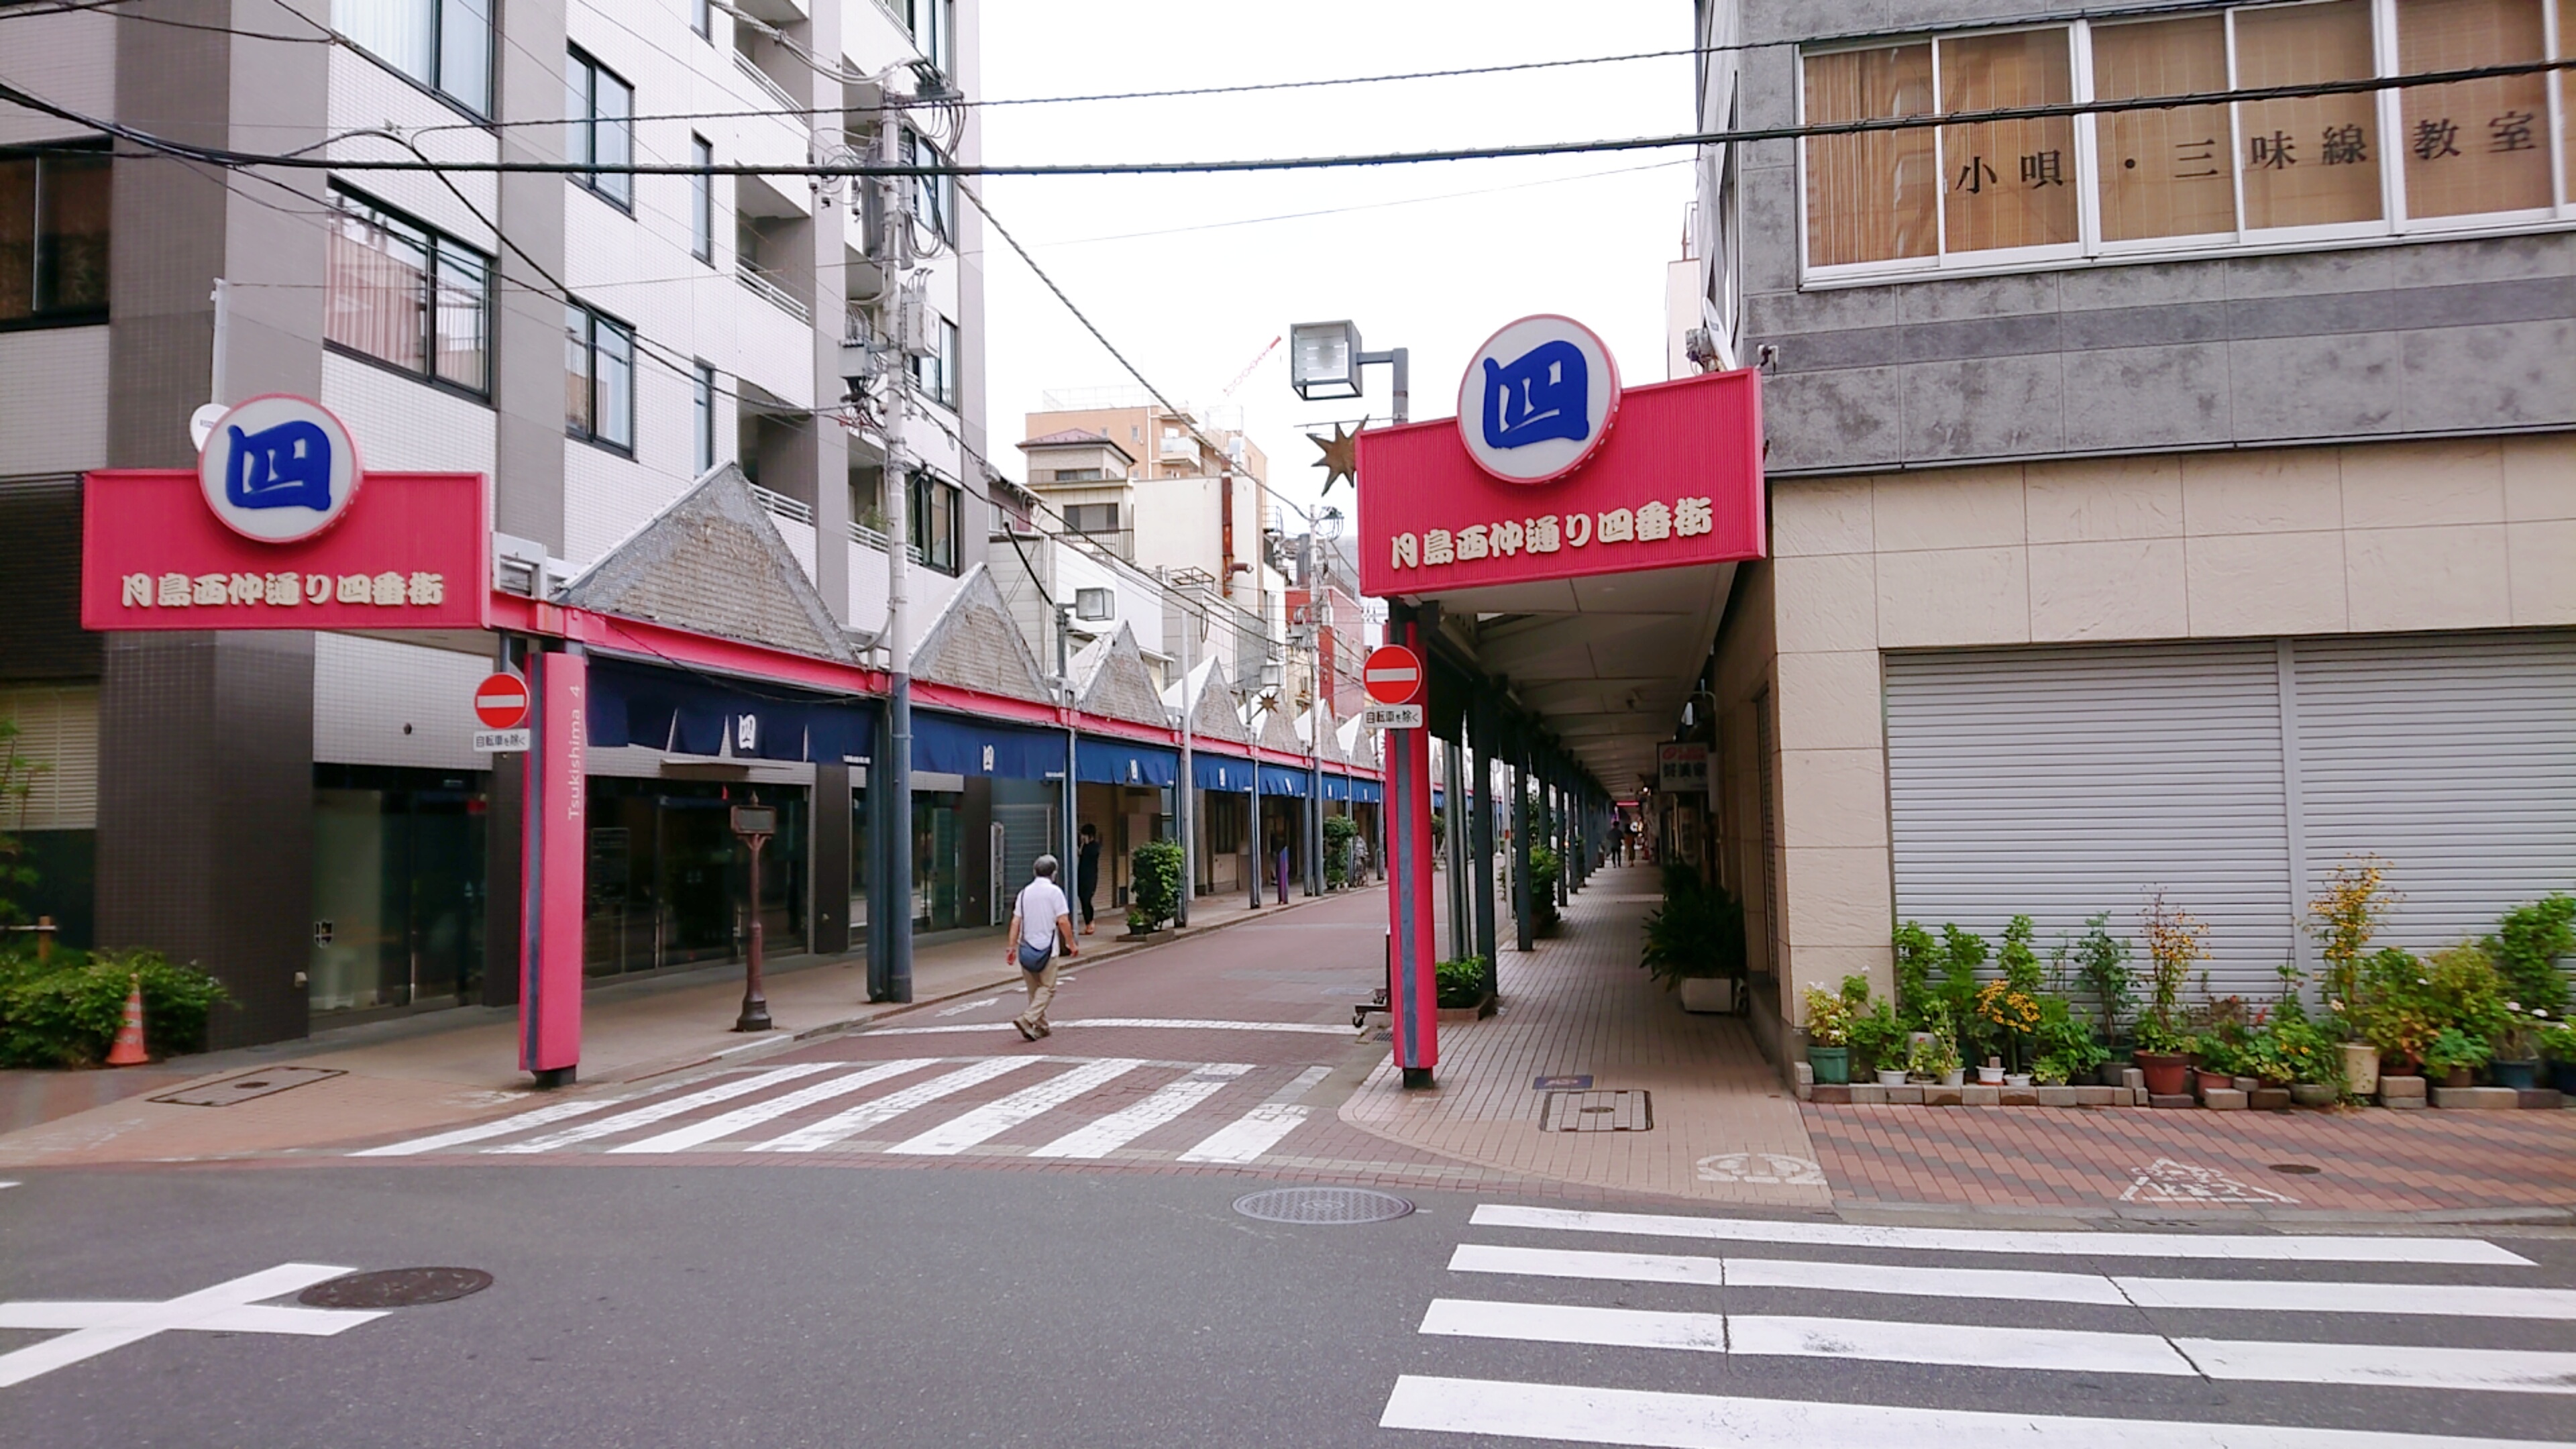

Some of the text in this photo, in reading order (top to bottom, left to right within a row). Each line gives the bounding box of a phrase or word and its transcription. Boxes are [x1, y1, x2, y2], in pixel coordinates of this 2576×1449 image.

[1954, 110, 2537, 194] 小唄・三味線教室
[1483, 340, 1590, 449] 四
[225, 420, 332, 511] 四
[1391, 497, 1713, 570] 月島西仲通り四番街
[122, 572, 444, 606] 月島西仲通り四番街
[476, 734, 526, 748] 自転車を除く
[568, 685, 580, 820] Tsukishima 4
[1366, 709, 1419, 724] 自転車を除く
